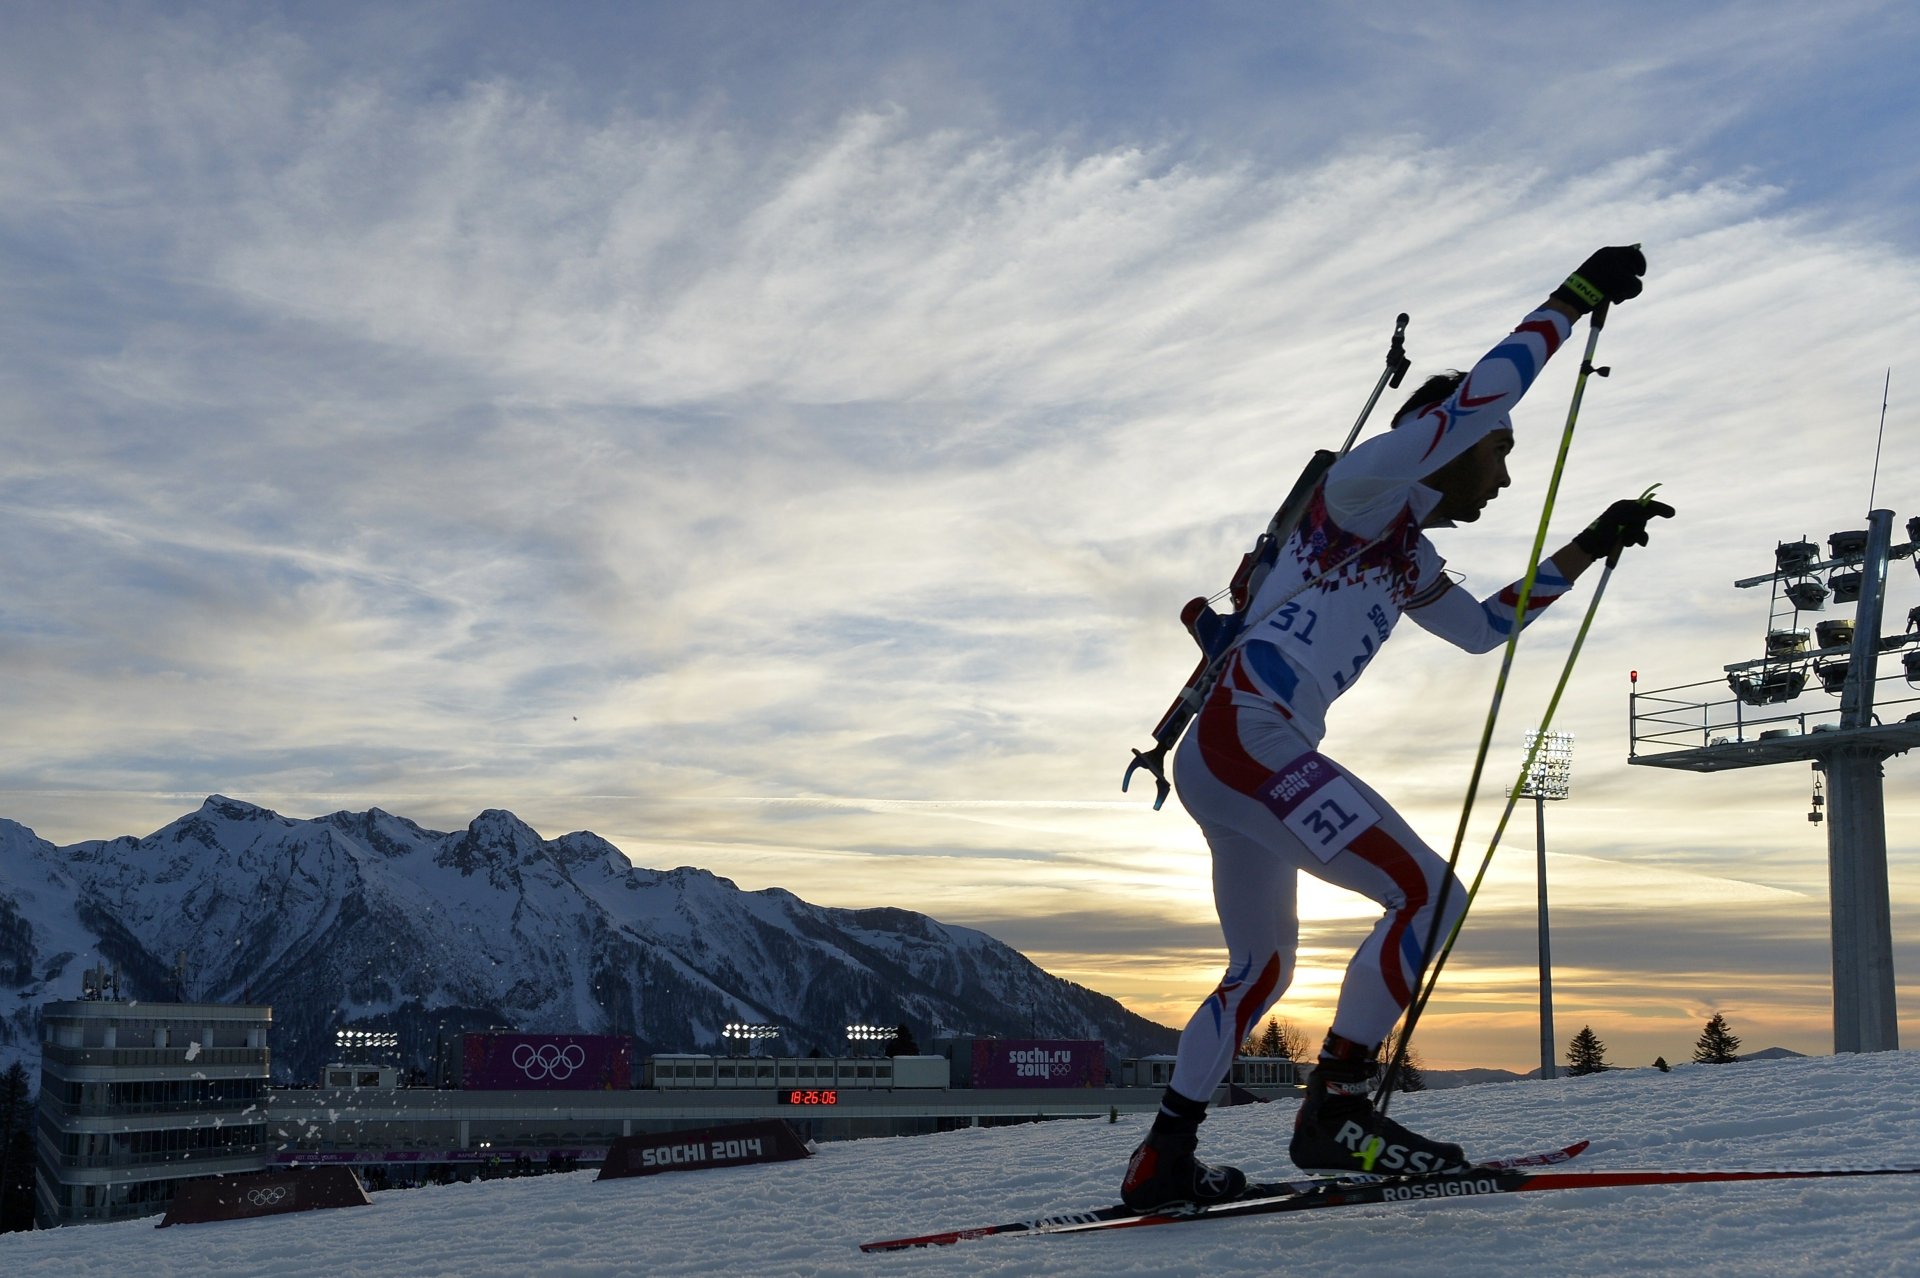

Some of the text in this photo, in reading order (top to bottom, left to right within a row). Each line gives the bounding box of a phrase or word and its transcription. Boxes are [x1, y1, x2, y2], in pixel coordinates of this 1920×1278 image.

[1269, 602, 1318, 645] 31
[1269, 761, 1320, 800] sochi.ru
[1281, 778, 1311, 802] 2014
[1302, 799, 1359, 845] 31
[1009, 1048, 1071, 1064] sochi.ru
[1016, 1063, 1050, 1080] 2014
[790, 1091, 837, 1105] 18:26:06
[642, 1138, 762, 1166] SOCHI 2014
[1383, 1178, 1505, 1202] ROSSIGNOL
